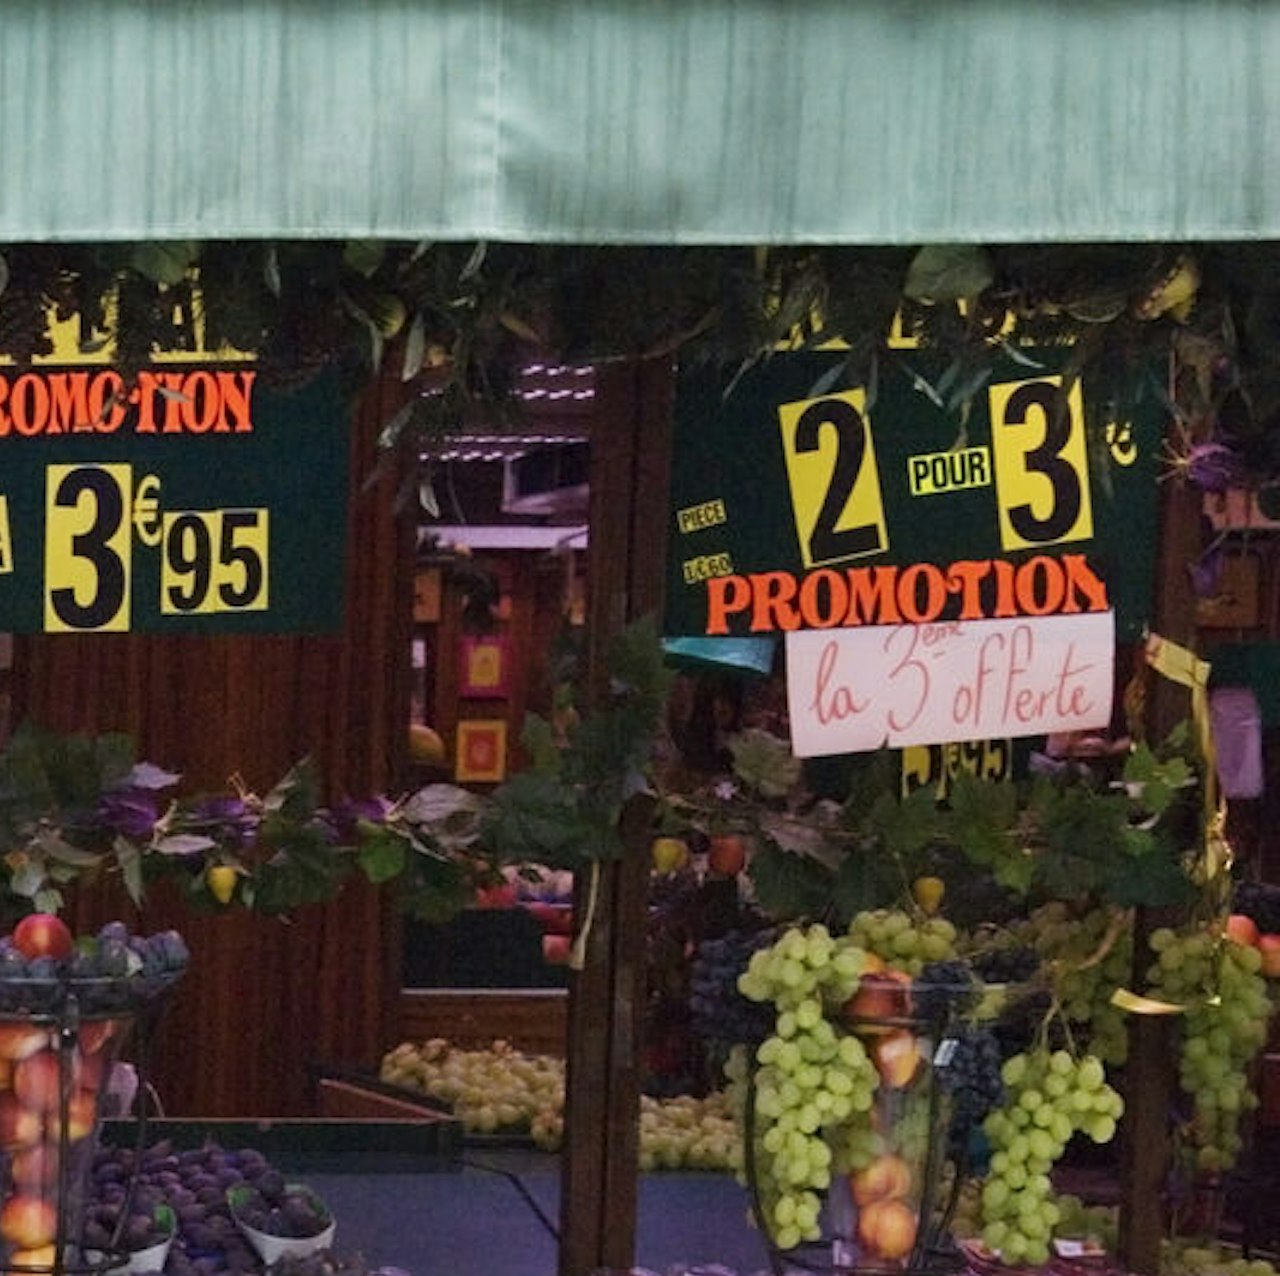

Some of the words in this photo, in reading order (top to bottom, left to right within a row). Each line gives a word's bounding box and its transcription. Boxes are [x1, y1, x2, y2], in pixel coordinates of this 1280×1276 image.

[913, 451, 988, 491] POUR
[682, 503, 724, 529] PIECE
[706, 554, 1109, 635] PROMOTION
[811, 641, 870, 726] la
[952, 625, 1095, 728] offerte
